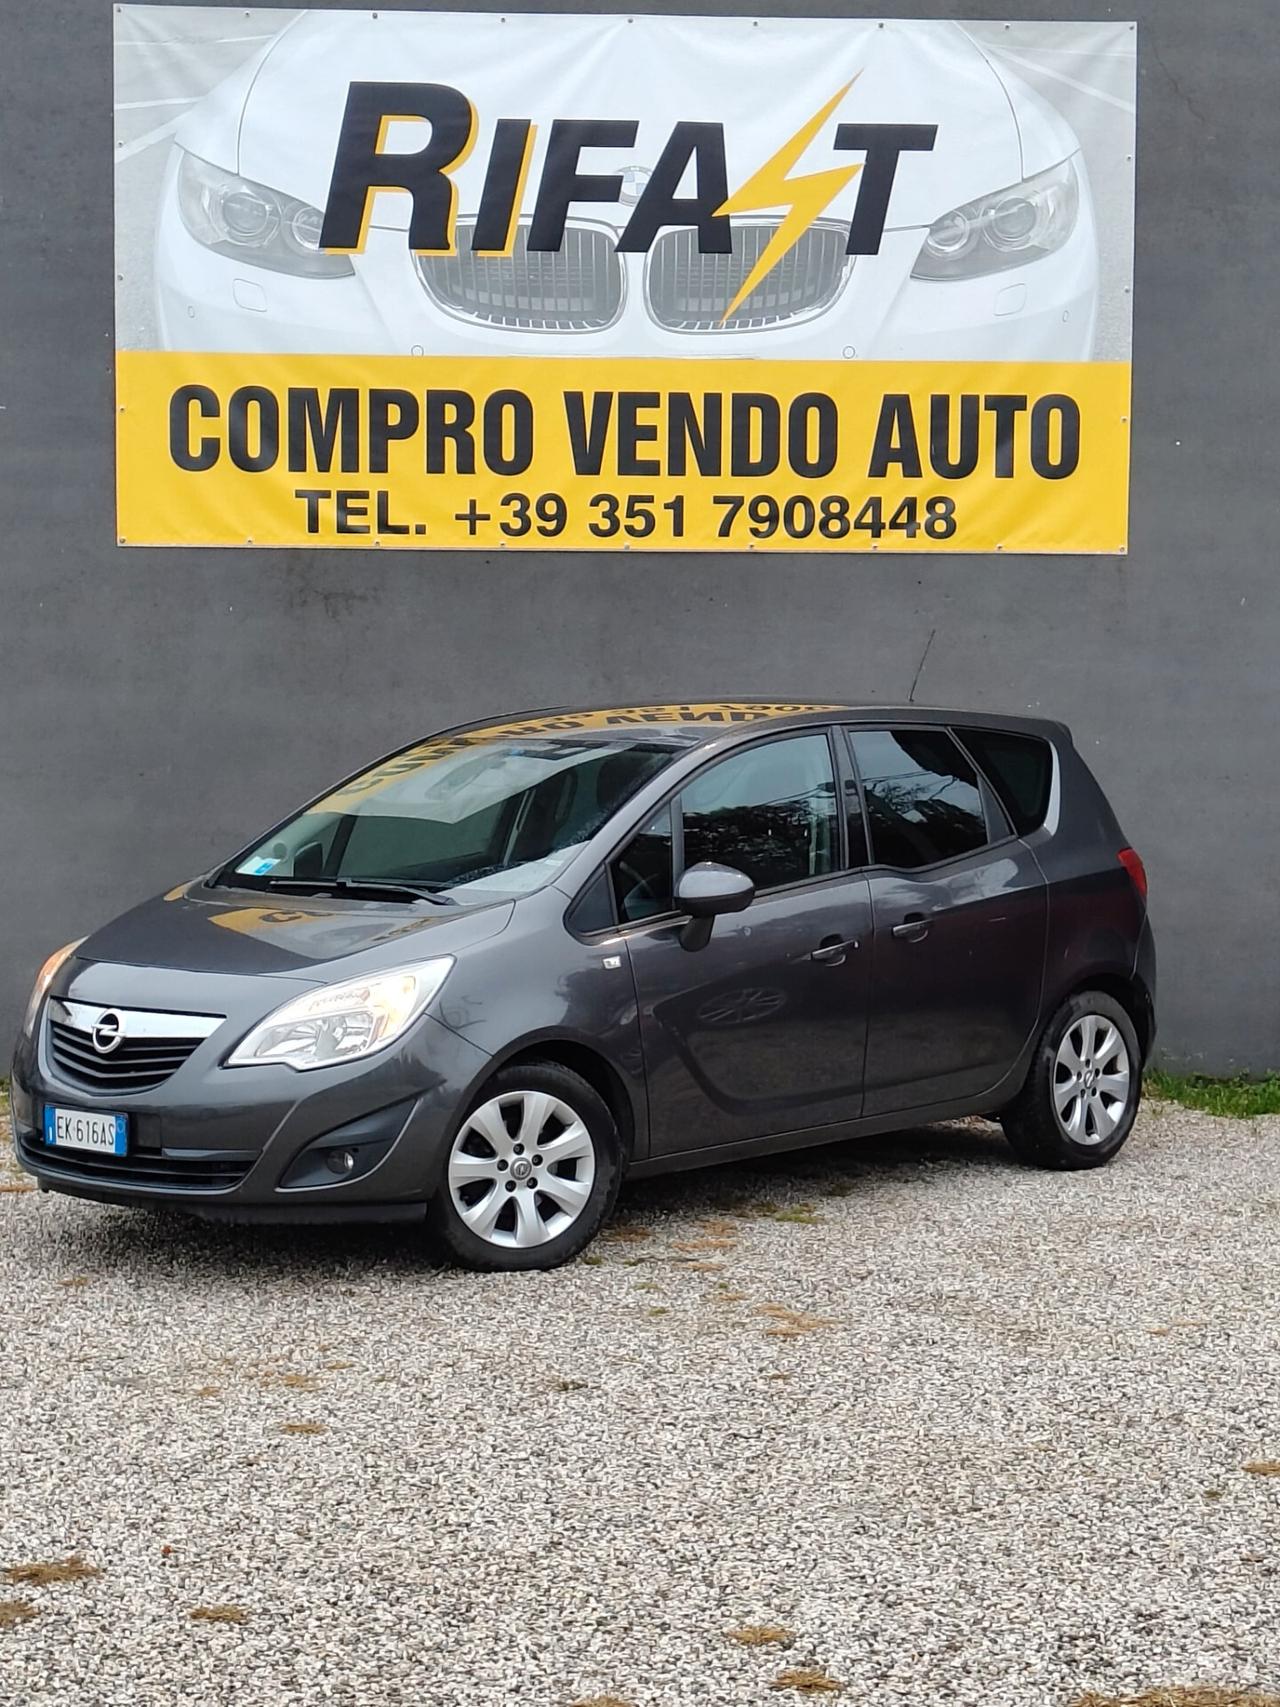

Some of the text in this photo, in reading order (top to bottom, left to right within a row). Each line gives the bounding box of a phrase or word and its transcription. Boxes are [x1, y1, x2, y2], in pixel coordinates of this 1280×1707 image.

[169, 384, 1081, 480] COMPRO VENDO AUTO
[295, 489, 957, 540] TEL. +39 351 7908448
[57, 1116, 72, 1141] EK
[76, 1119, 115, 1146] 616AS
